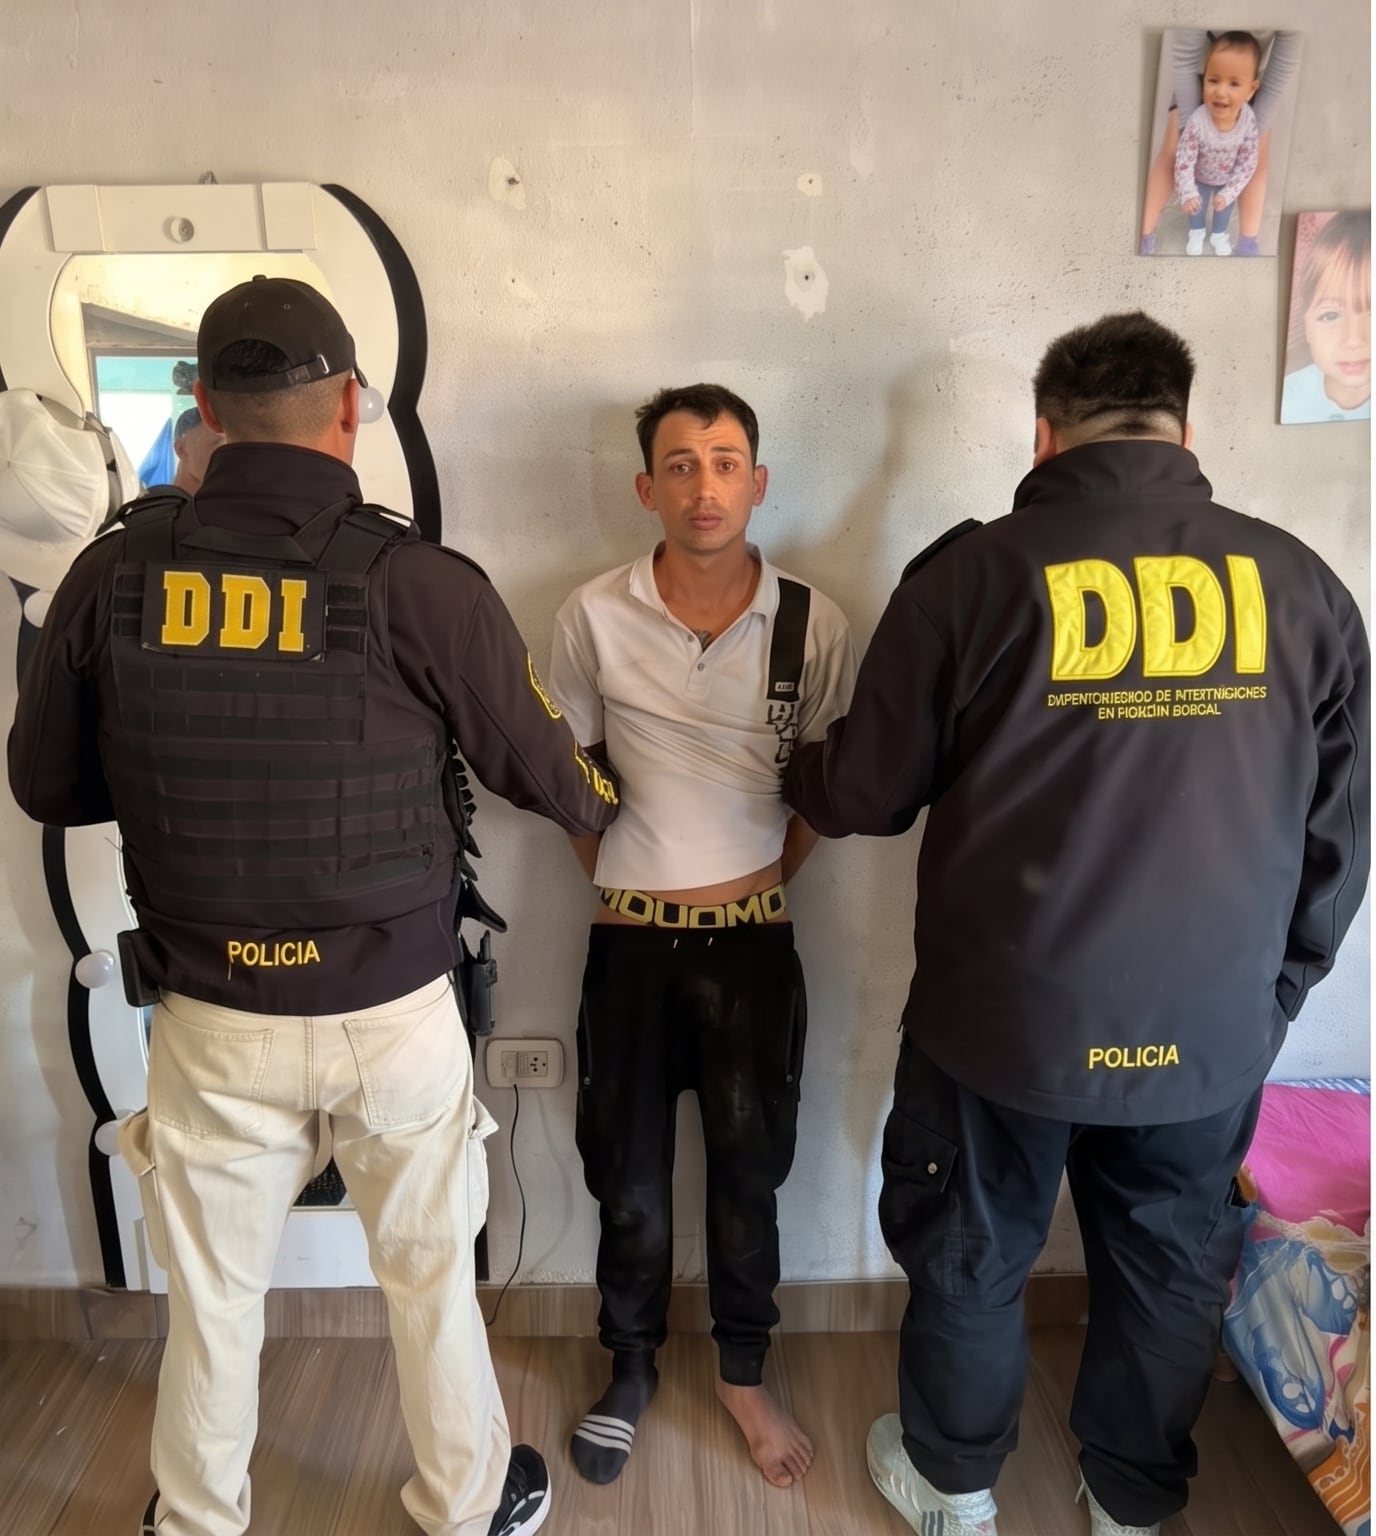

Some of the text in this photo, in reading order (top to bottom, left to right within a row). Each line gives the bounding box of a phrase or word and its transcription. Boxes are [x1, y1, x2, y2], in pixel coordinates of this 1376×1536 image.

[162, 571, 307, 652] DDI
[1045, 554, 1267, 681] DDI
[1156, 689, 1172, 702] DE
[1098, 707, 1115, 719] EN
[227, 940, 320, 966] POLICIA
[1088, 1044, 1180, 1069] POLICIA
